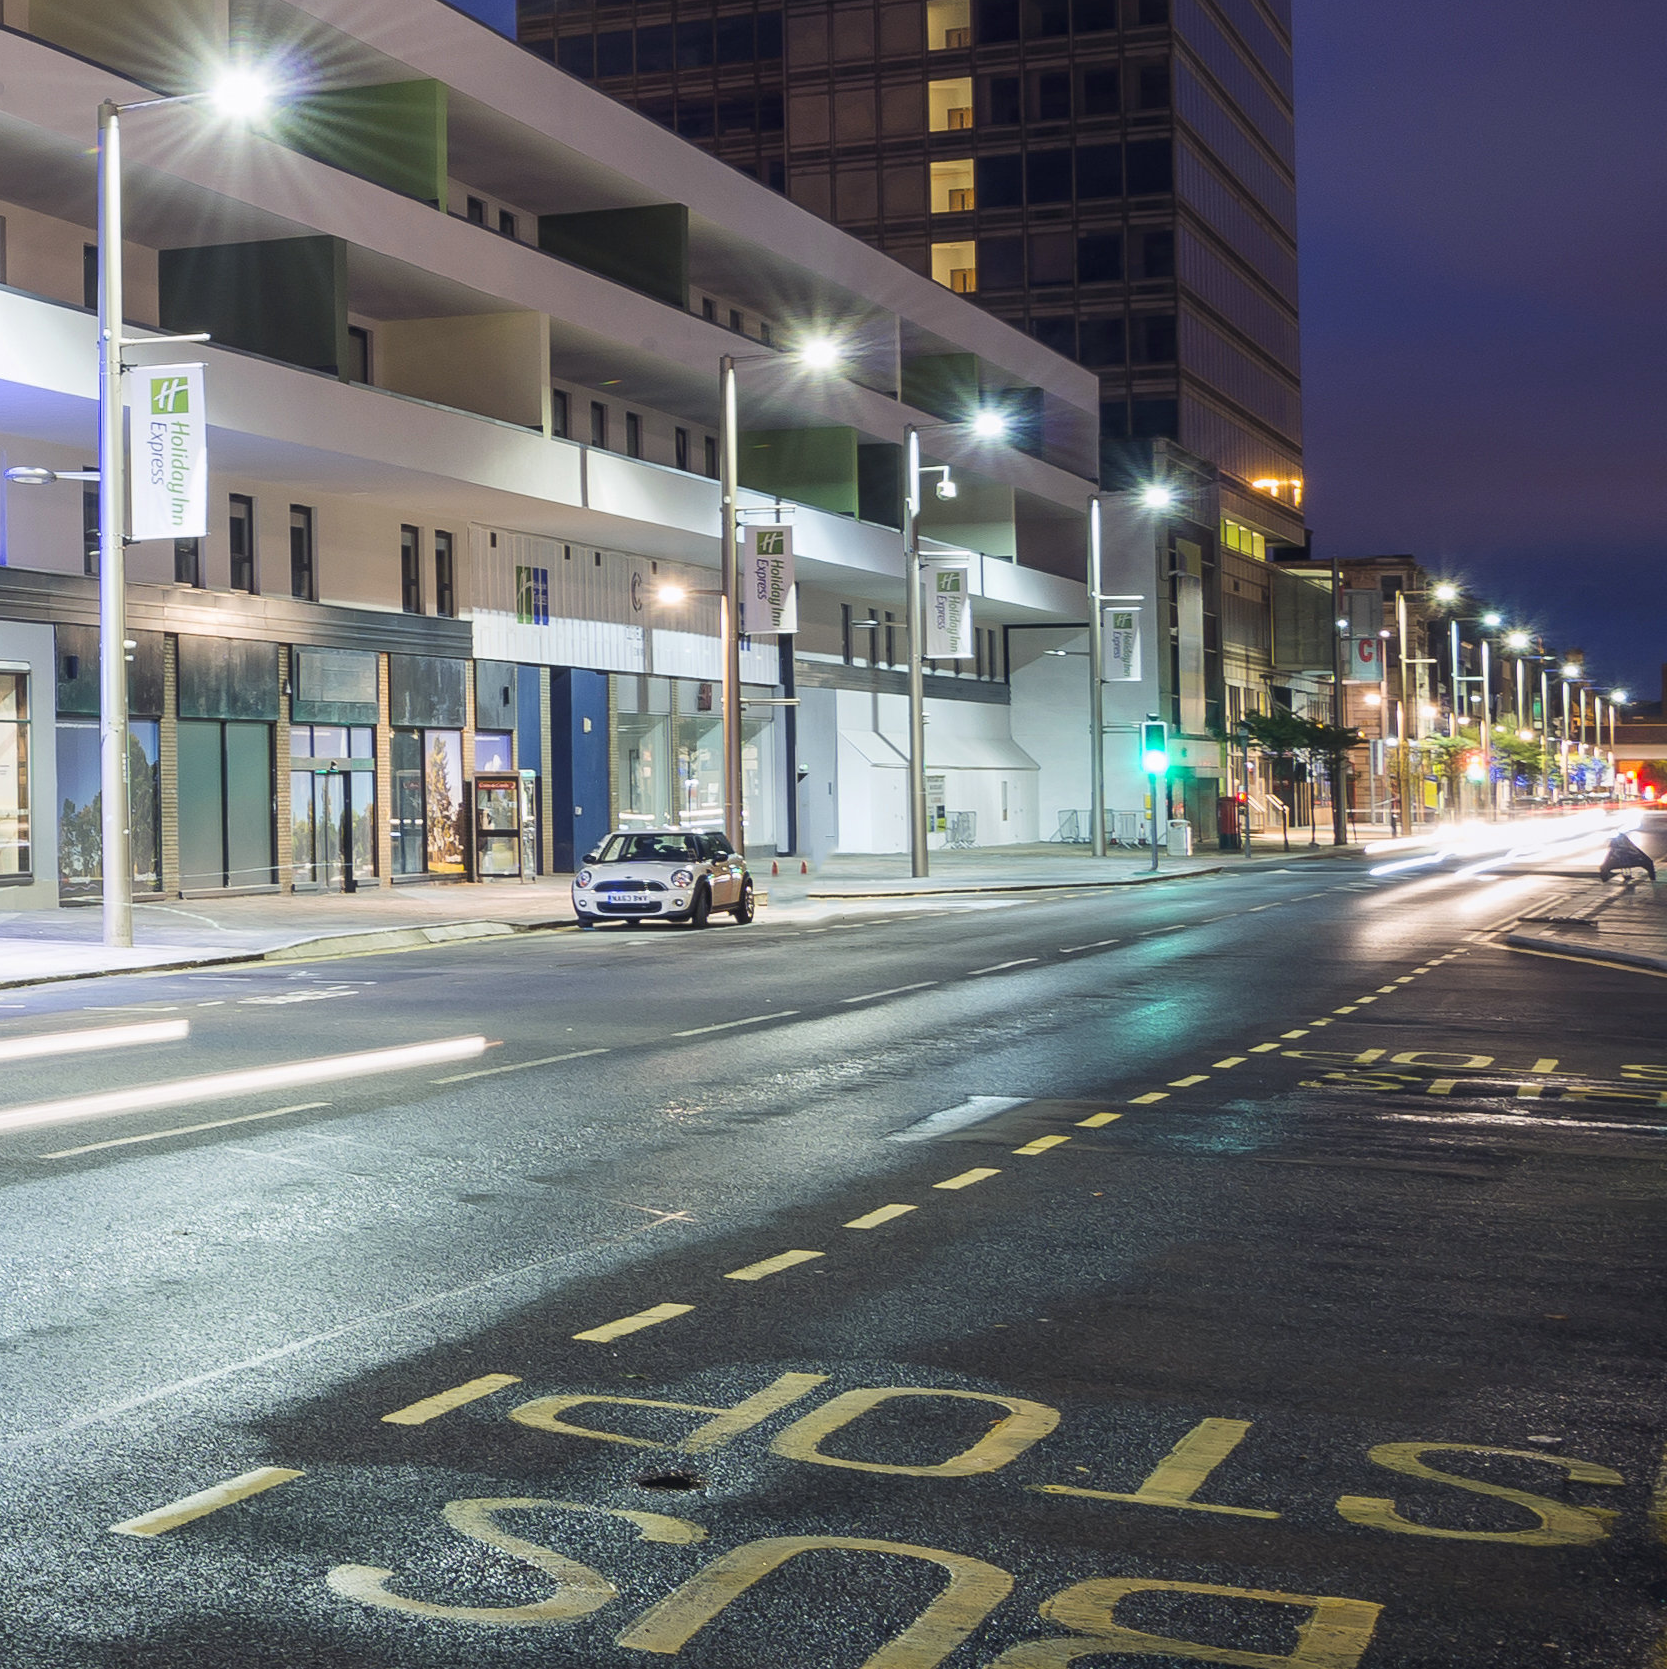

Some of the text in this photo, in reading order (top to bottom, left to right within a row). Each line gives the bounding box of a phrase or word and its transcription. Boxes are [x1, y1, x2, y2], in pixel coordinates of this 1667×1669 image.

[147, 421, 167, 485] Express
[166, 421, 190, 526] Holiday Inn
[755, 558, 769, 600] Express
[768, 558, 785, 627] Holiday Inn
[935, 595, 947, 630] Express
[947, 595, 961, 652] Holiday Inn
[507, 1372, 1626, 1546] STOP
